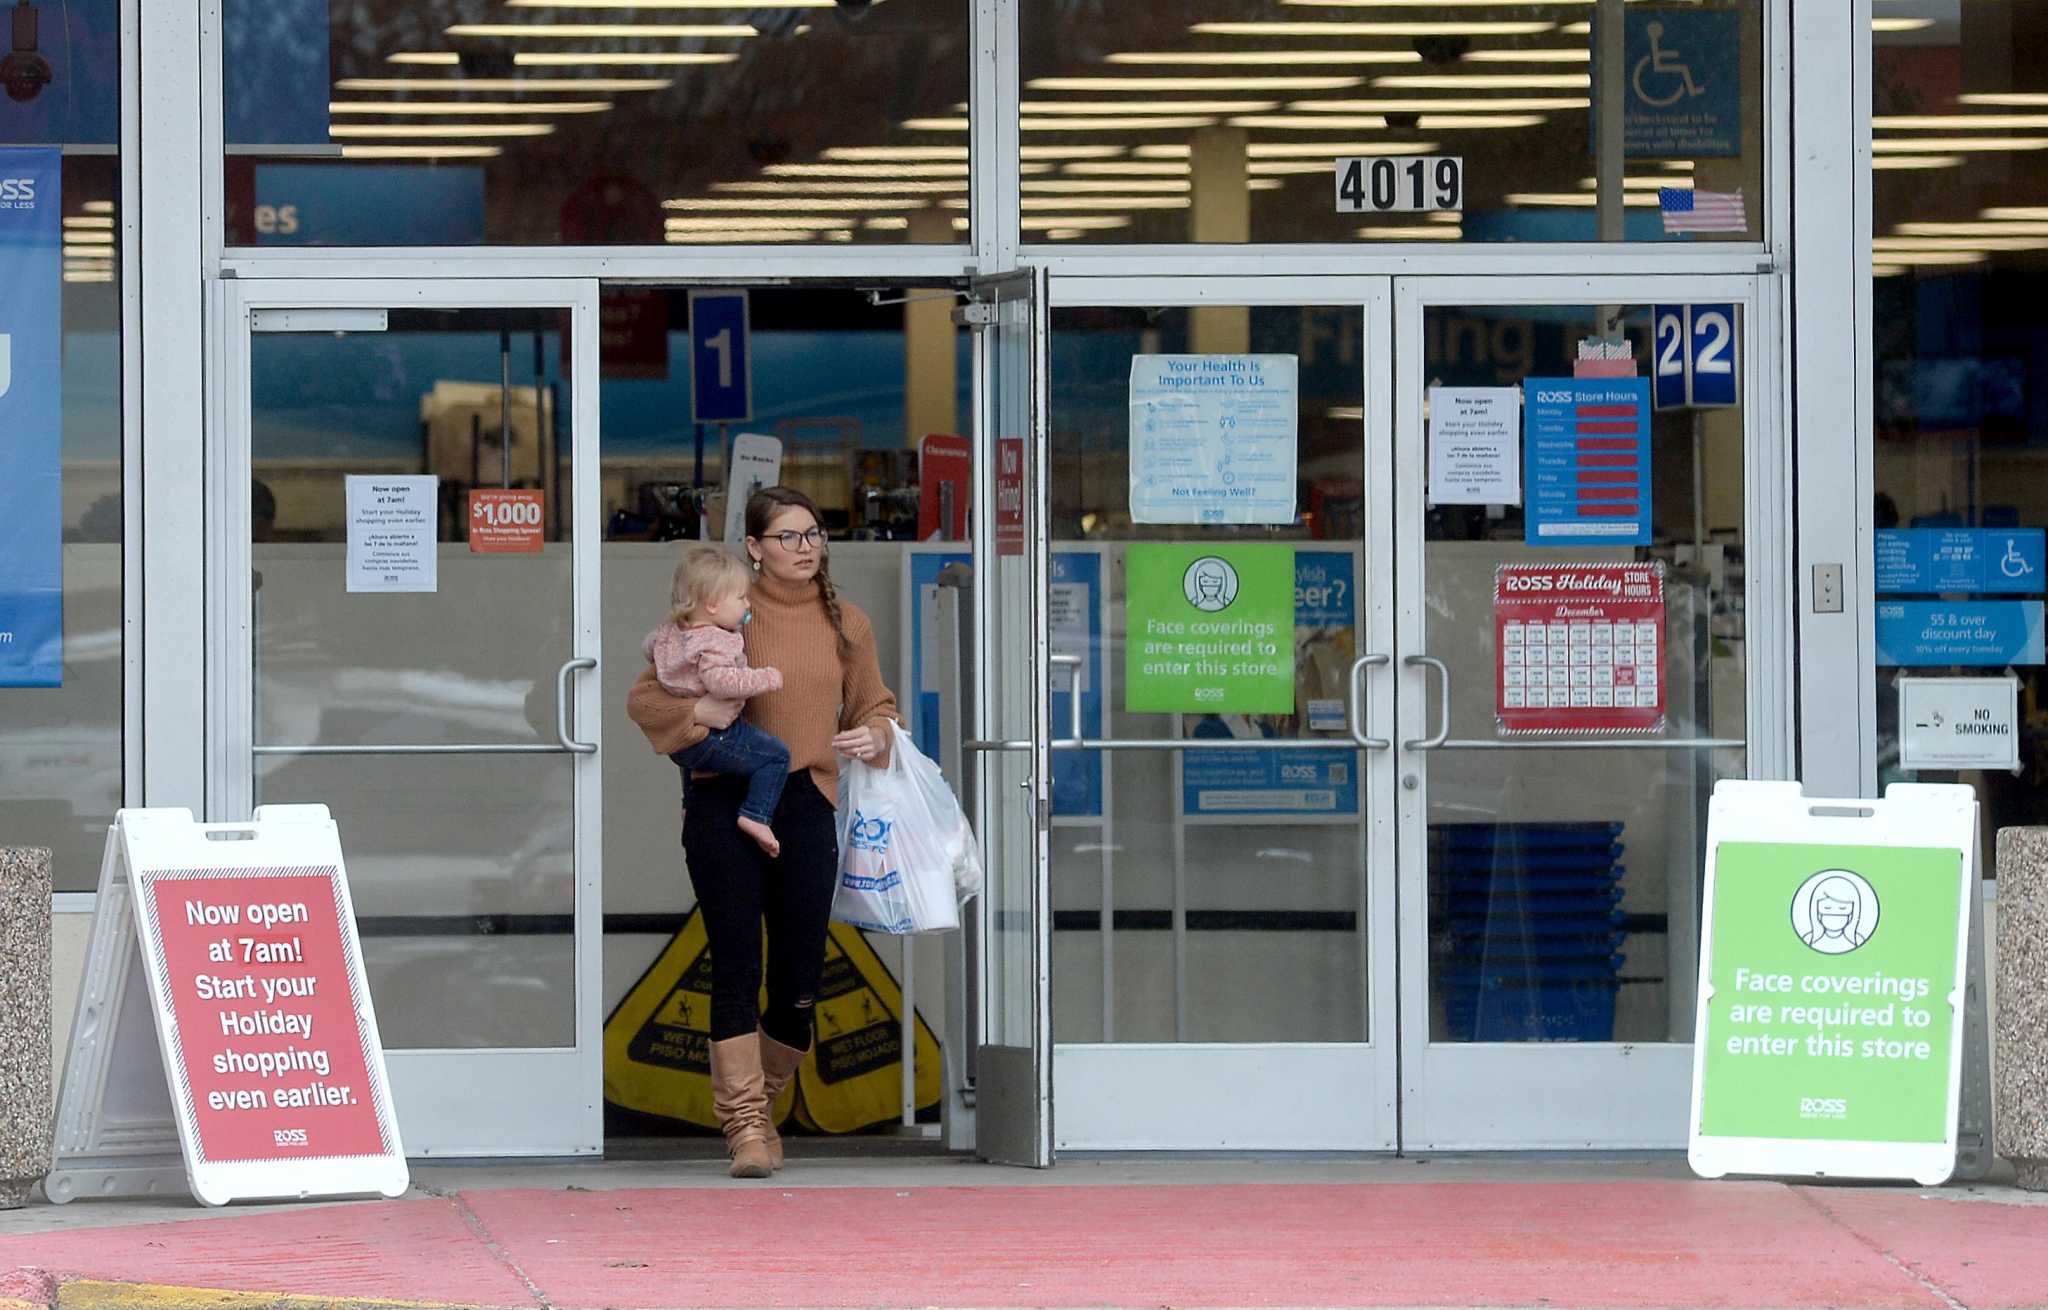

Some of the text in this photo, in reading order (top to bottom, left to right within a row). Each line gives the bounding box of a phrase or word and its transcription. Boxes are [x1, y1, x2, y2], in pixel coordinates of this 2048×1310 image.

[0, 179, 34, 200] SS
[1340, 159, 1462, 210] 4019
[1658, 314, 1682, 376] 2
[1695, 312, 1731, 373] 2
[704, 328, 732, 388] 1
[1167, 360, 1261, 373] Your Health Is
[1158, 375, 1265, 388] Important To Us
[1474, 398, 1493, 406] open
[1537, 391, 1638, 402] ROSS Store Hours
[391, 486, 410, 494] open
[1172, 487, 1256, 498] Not Feeling Well?
[387, 496, 405, 504] 7am!
[473, 501, 541, 526] $1,000
[1296, 564, 1327, 585] ylish
[1506, 571, 1650, 596] ROSS Holiday STORE
[1295, 579, 1347, 609] eer?
[1624, 585, 1652, 597] HOURS
[1555, 604, 1604, 617] December
[1146, 619, 1275, 639] Face coverings
[1948, 614, 1958, 626] &
[1960, 615, 1986, 626] over
[1921, 627, 1997, 641] discount day
[1144, 640, 1277, 658] are required to
[1143, 660, 1278, 677] enter this store
[1194, 687, 1225, 698] ROSS
[1974, 709, 1990, 720] NO
[1955, 723, 2009, 735] SMOKING
[1281, 765, 1318, 779] ROSS
[185, 900, 309, 929] Now open
[208, 937, 304, 964] at 7am!
[195, 974, 318, 1004] Start your
[1734, 968, 1930, 1003] Face coverings
[219, 1010, 313, 1039] Holiday
[1729, 1003, 1931, 1032] are required to
[663, 1032, 694, 1048] WET
[1727, 1034, 1931, 1060] enter this store
[213, 1046, 331, 1078] shopping
[208, 1082, 358, 1110] even earlier.
[1800, 1097, 1847, 1113] ROSS
[273, 1129, 307, 1142] ROSS
